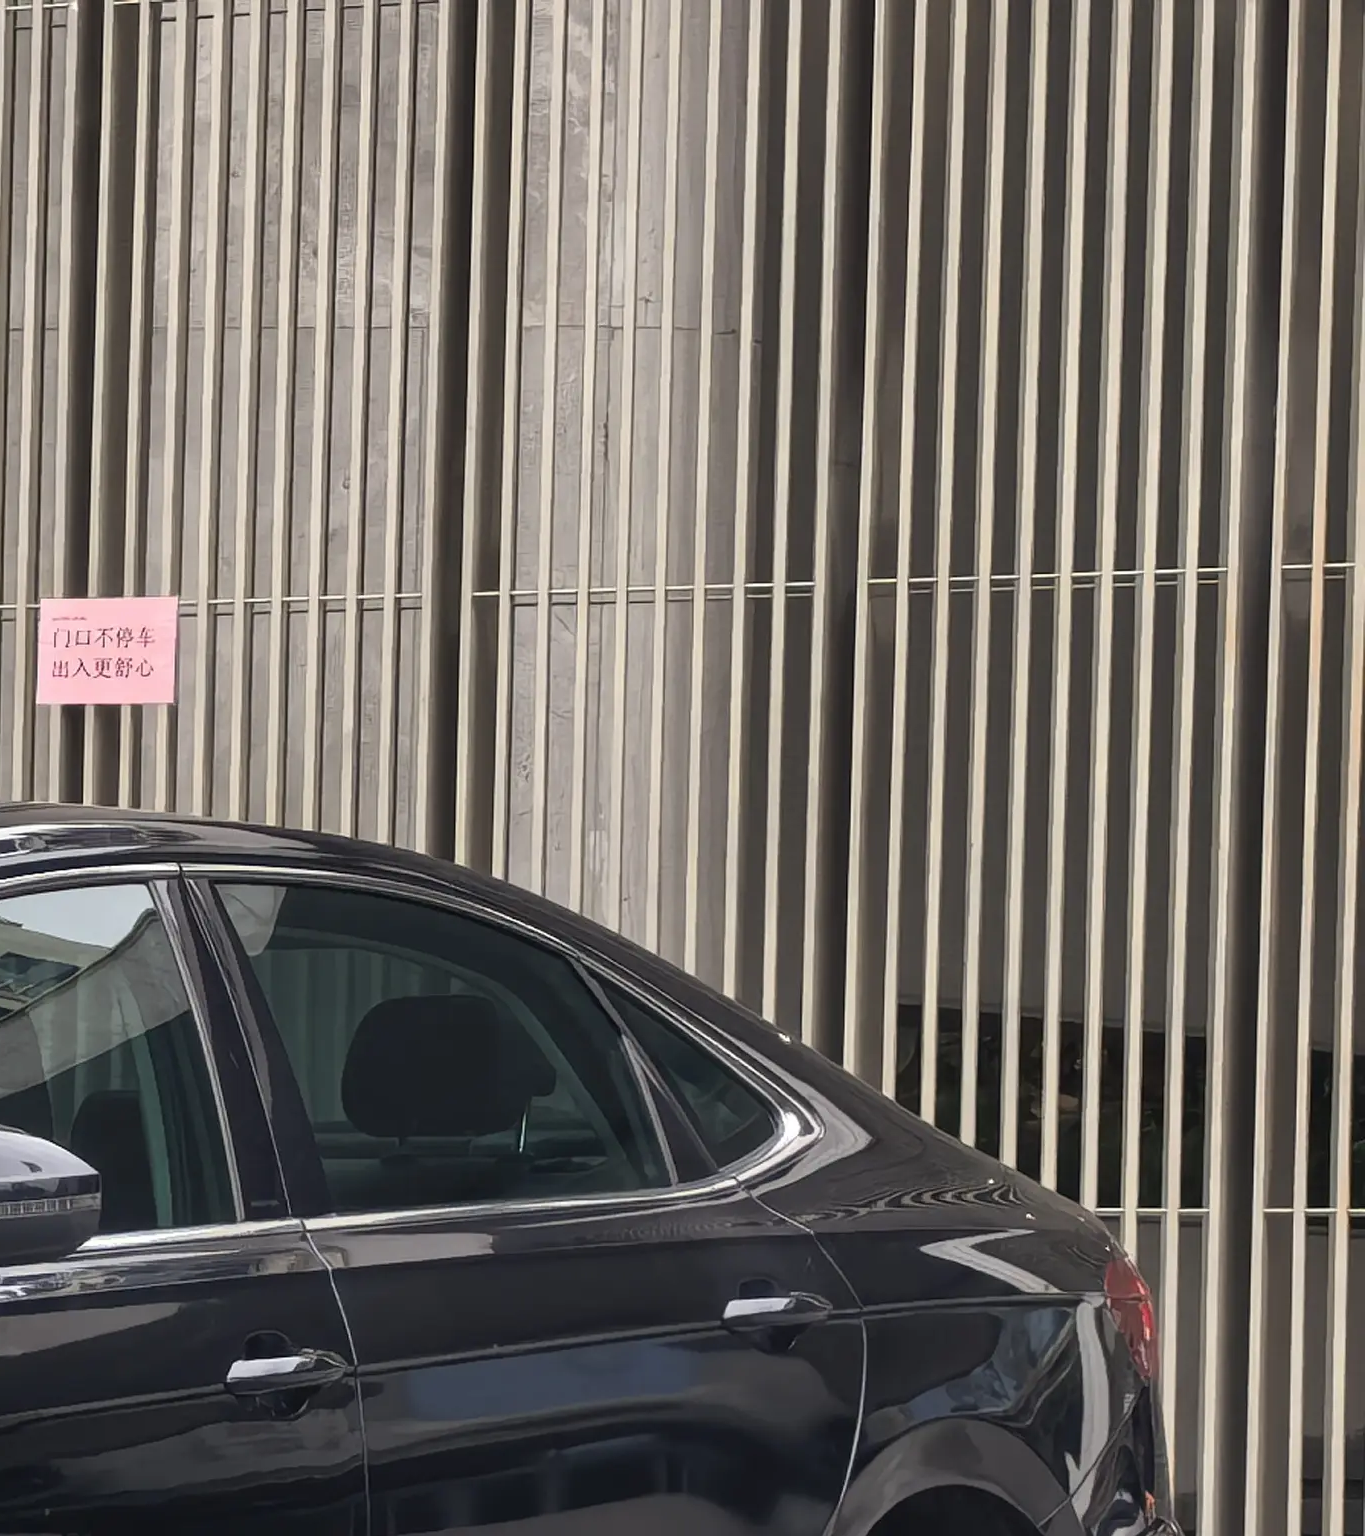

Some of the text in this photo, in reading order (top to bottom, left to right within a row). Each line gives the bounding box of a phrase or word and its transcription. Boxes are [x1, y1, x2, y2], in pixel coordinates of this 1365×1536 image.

[52, 626, 156, 649] 门口不停车
[51, 657, 155, 679] 出入更舒心
